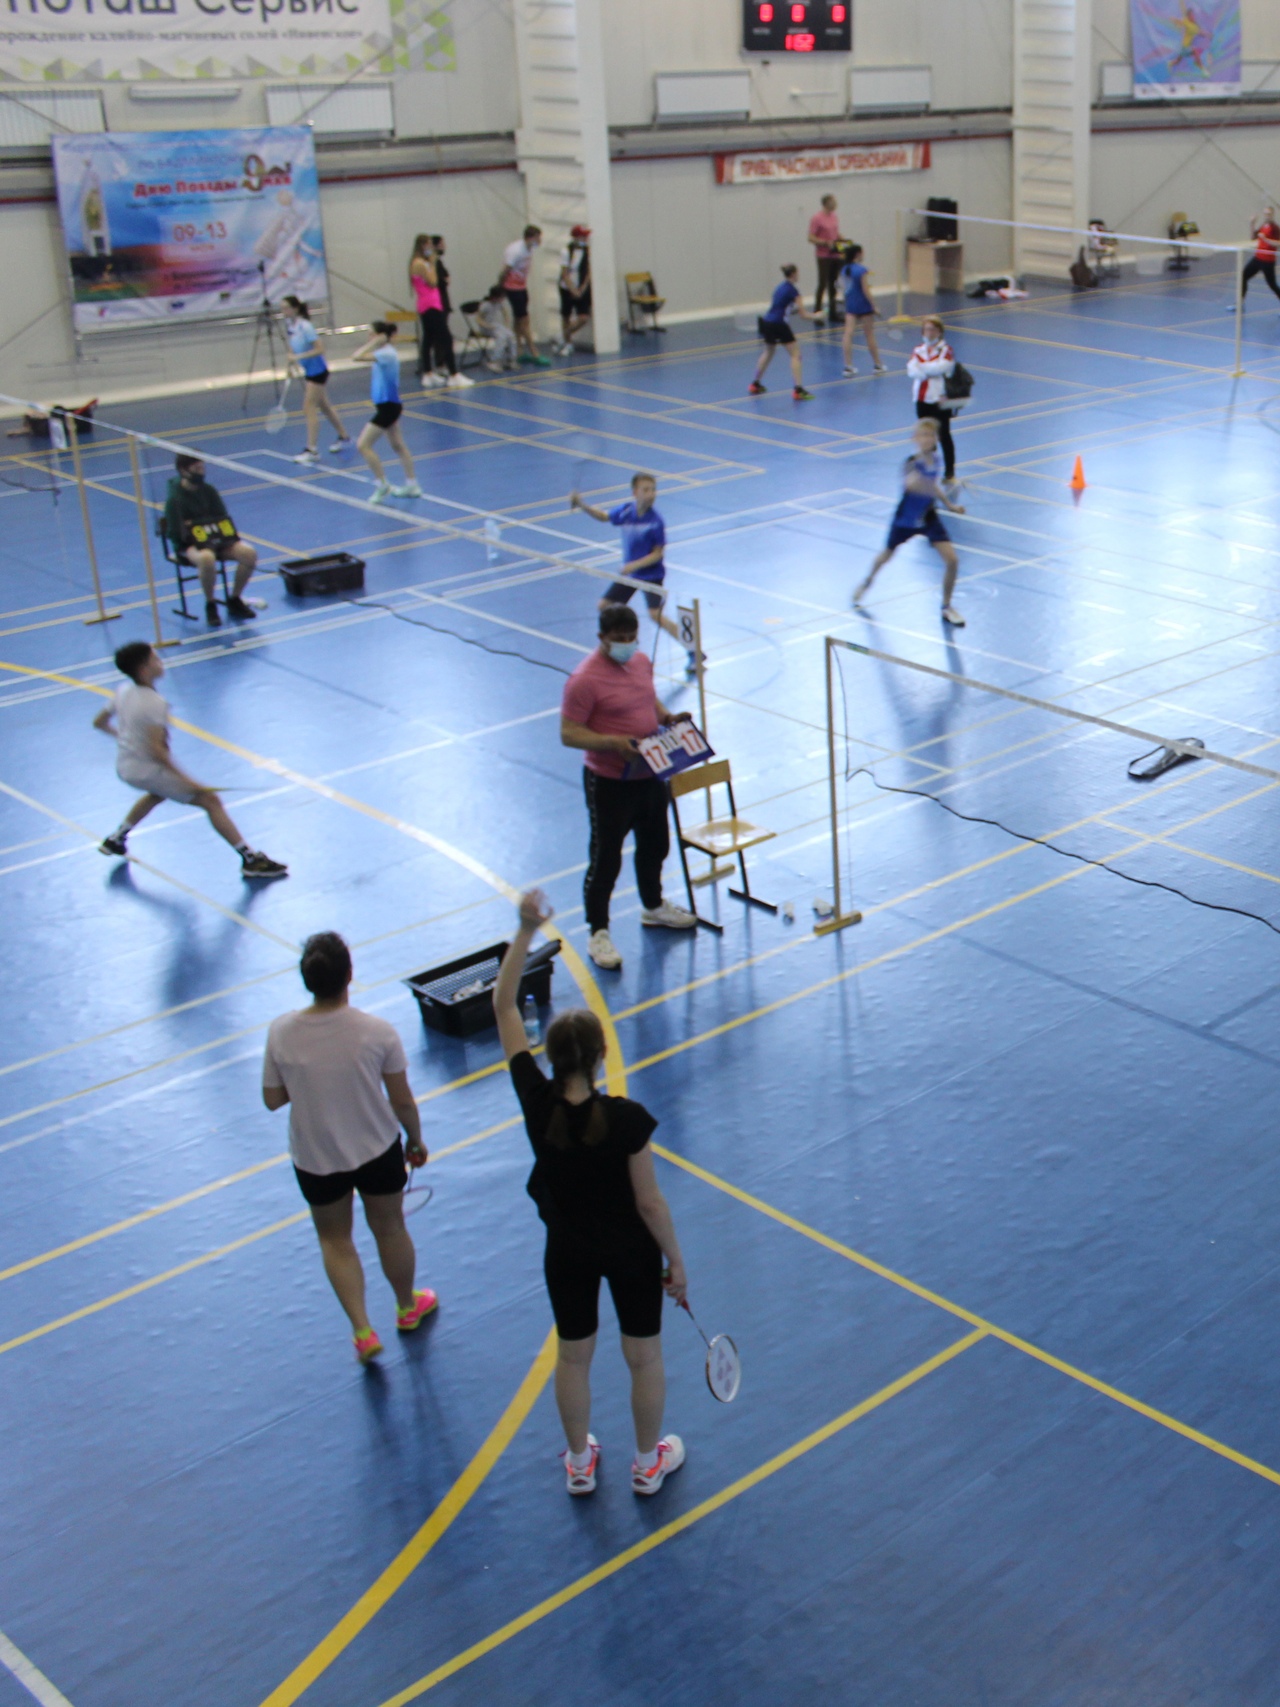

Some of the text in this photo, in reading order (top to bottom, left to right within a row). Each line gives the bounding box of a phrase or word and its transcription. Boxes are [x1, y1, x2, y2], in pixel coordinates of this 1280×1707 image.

[681, 615, 694, 644] 8
[645, 745, 668, 769] 17
[681, 729, 703, 753] 17
